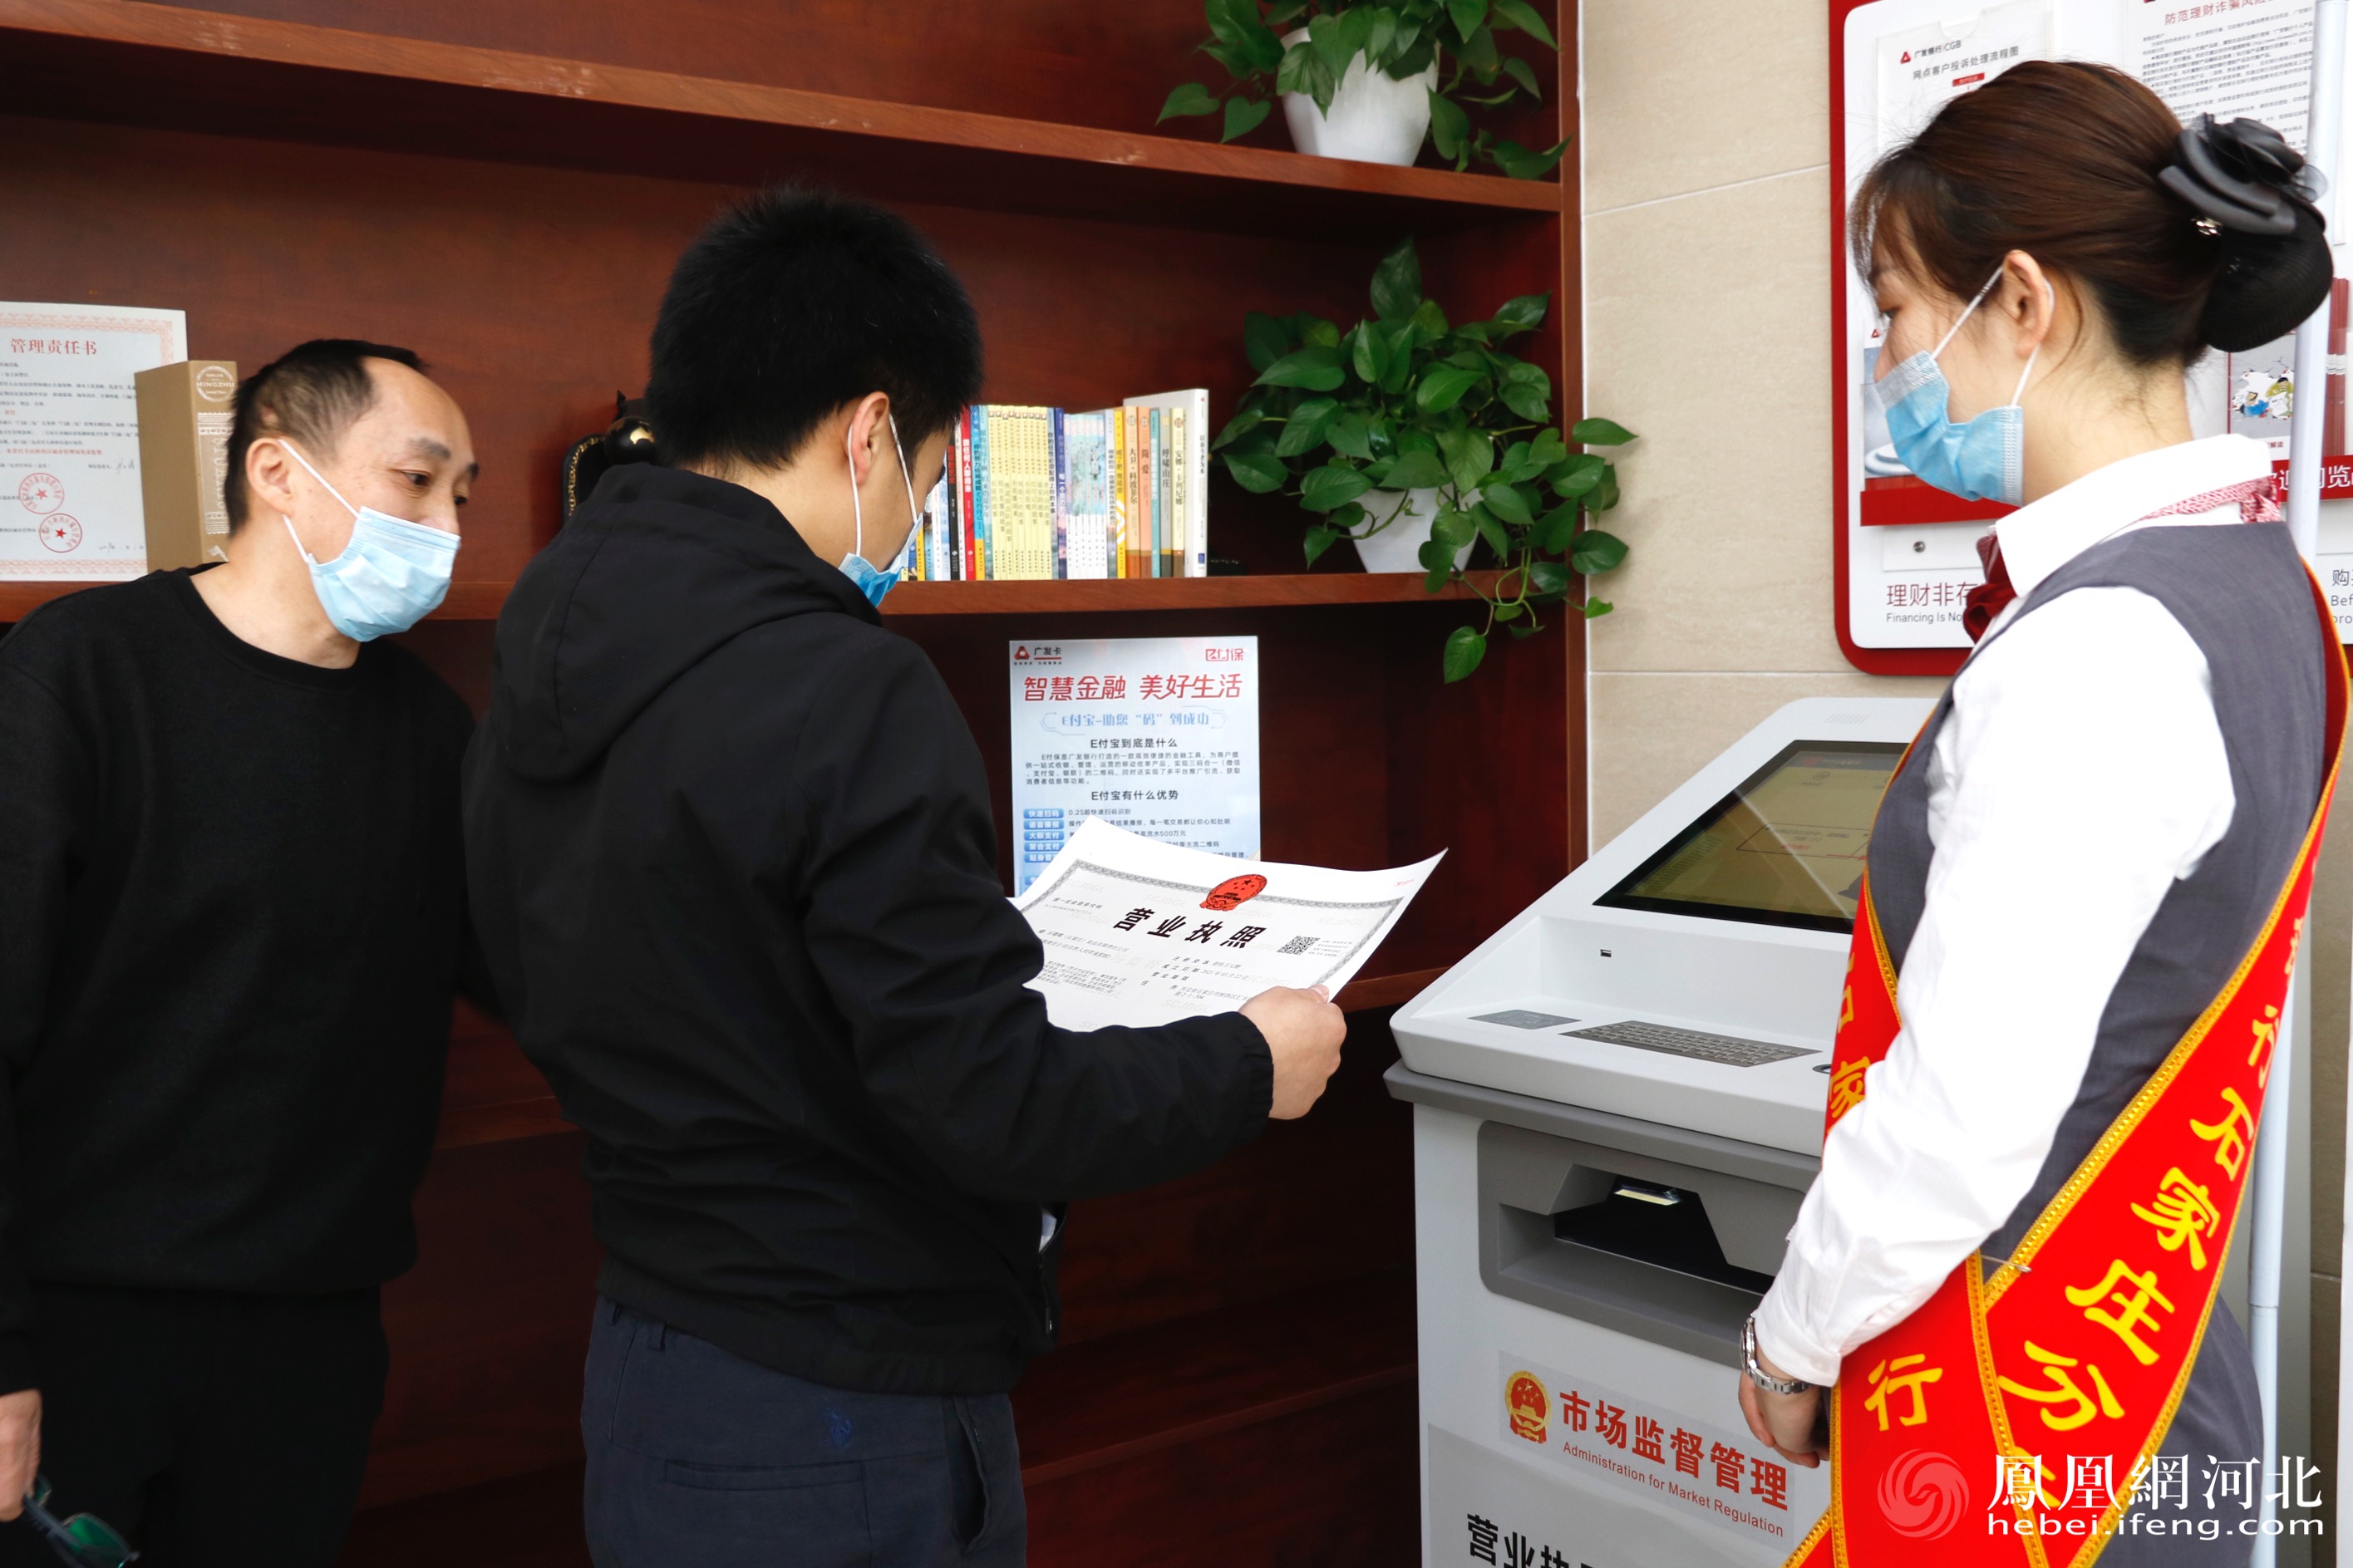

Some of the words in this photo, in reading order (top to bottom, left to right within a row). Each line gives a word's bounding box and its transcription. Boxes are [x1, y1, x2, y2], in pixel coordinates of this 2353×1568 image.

[1914, 45, 1942, 58] 广发银行
[1944, 41, 1962, 52] CGB
[1913, 46, 2020, 81] 网点客户投诉处理流程图
[11, 338, 97, 356] 管理责任书
[1162, 449, 1170, 489] 呼啸山庄
[1886, 612, 1933, 624] Financing
[1937, 612, 1945, 622] Is
[1034, 646, 1061, 656] 广发卡
[1024, 676, 1127, 701] 智慧金融
[1140, 674, 1243, 700] 美好生活
[1090, 738, 1179, 749] E付宝到底是什么
[1091, 790, 1179, 801] E付宝有什么优势
[1029, 809, 1060, 818] 快速扫码
[1113, 907, 1267, 950] 营业执照
[1864, 1353, 1943, 1432] 行
[1559, 1390, 1788, 1511] 市场监督管理
[1563, 1441, 1646, 1483] Administration
[1648, 1473, 1666, 1491] for
[1668, 1481, 1711, 1510] Market
[1714, 1498, 1784, 1537] Regulation
